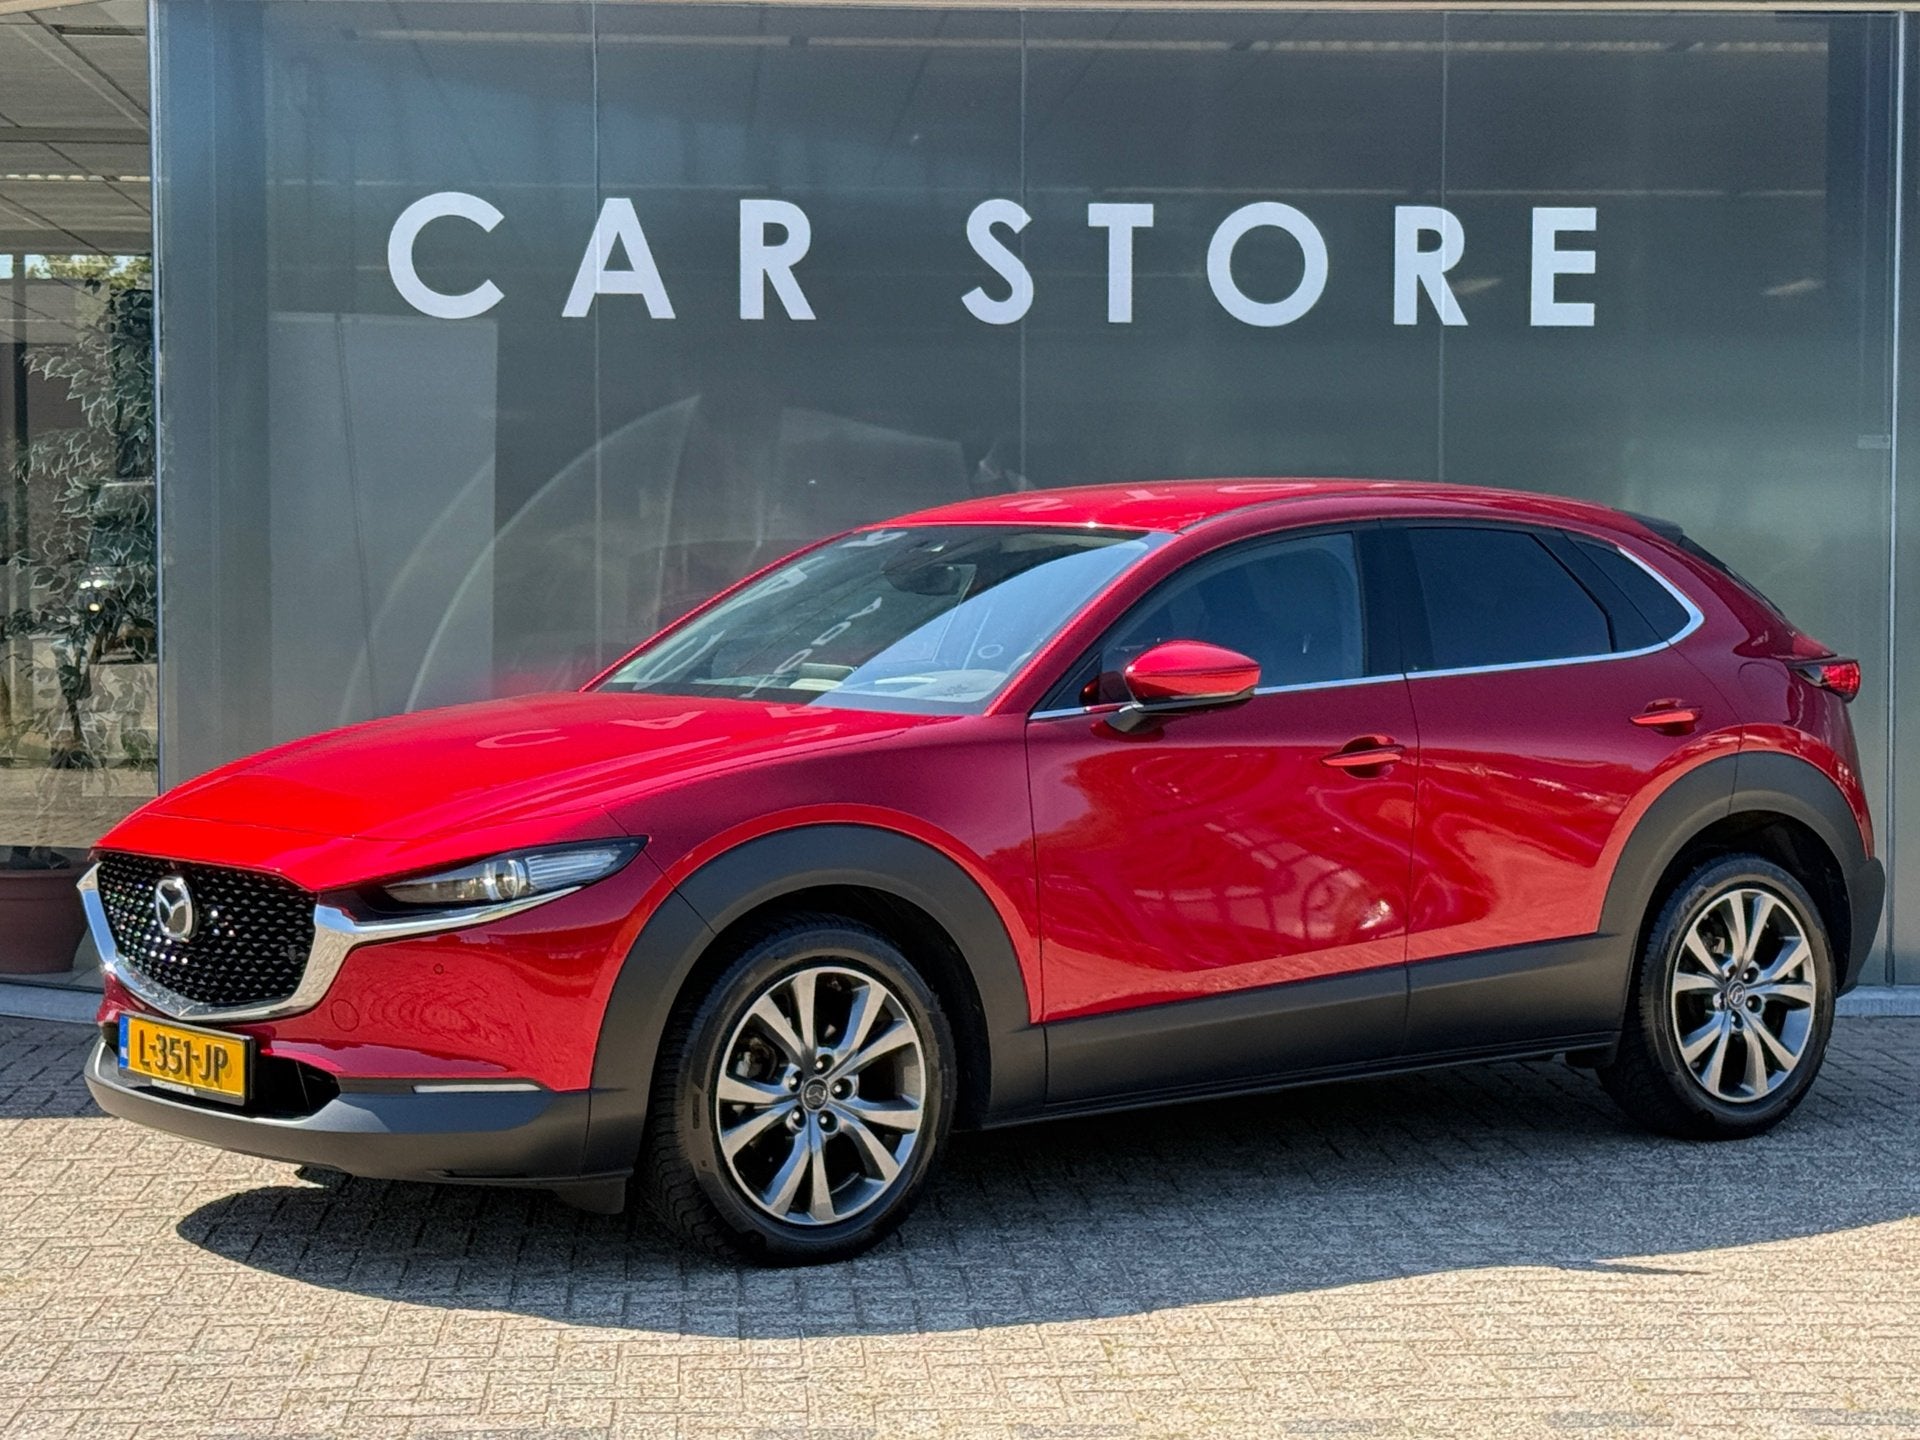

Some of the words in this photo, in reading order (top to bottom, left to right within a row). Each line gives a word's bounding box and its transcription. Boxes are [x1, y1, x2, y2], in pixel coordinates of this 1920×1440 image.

[387, 191, 817, 321] CAR
[961, 198, 1598, 328] STORE
[139, 1029, 229, 1083] L-351-JP
